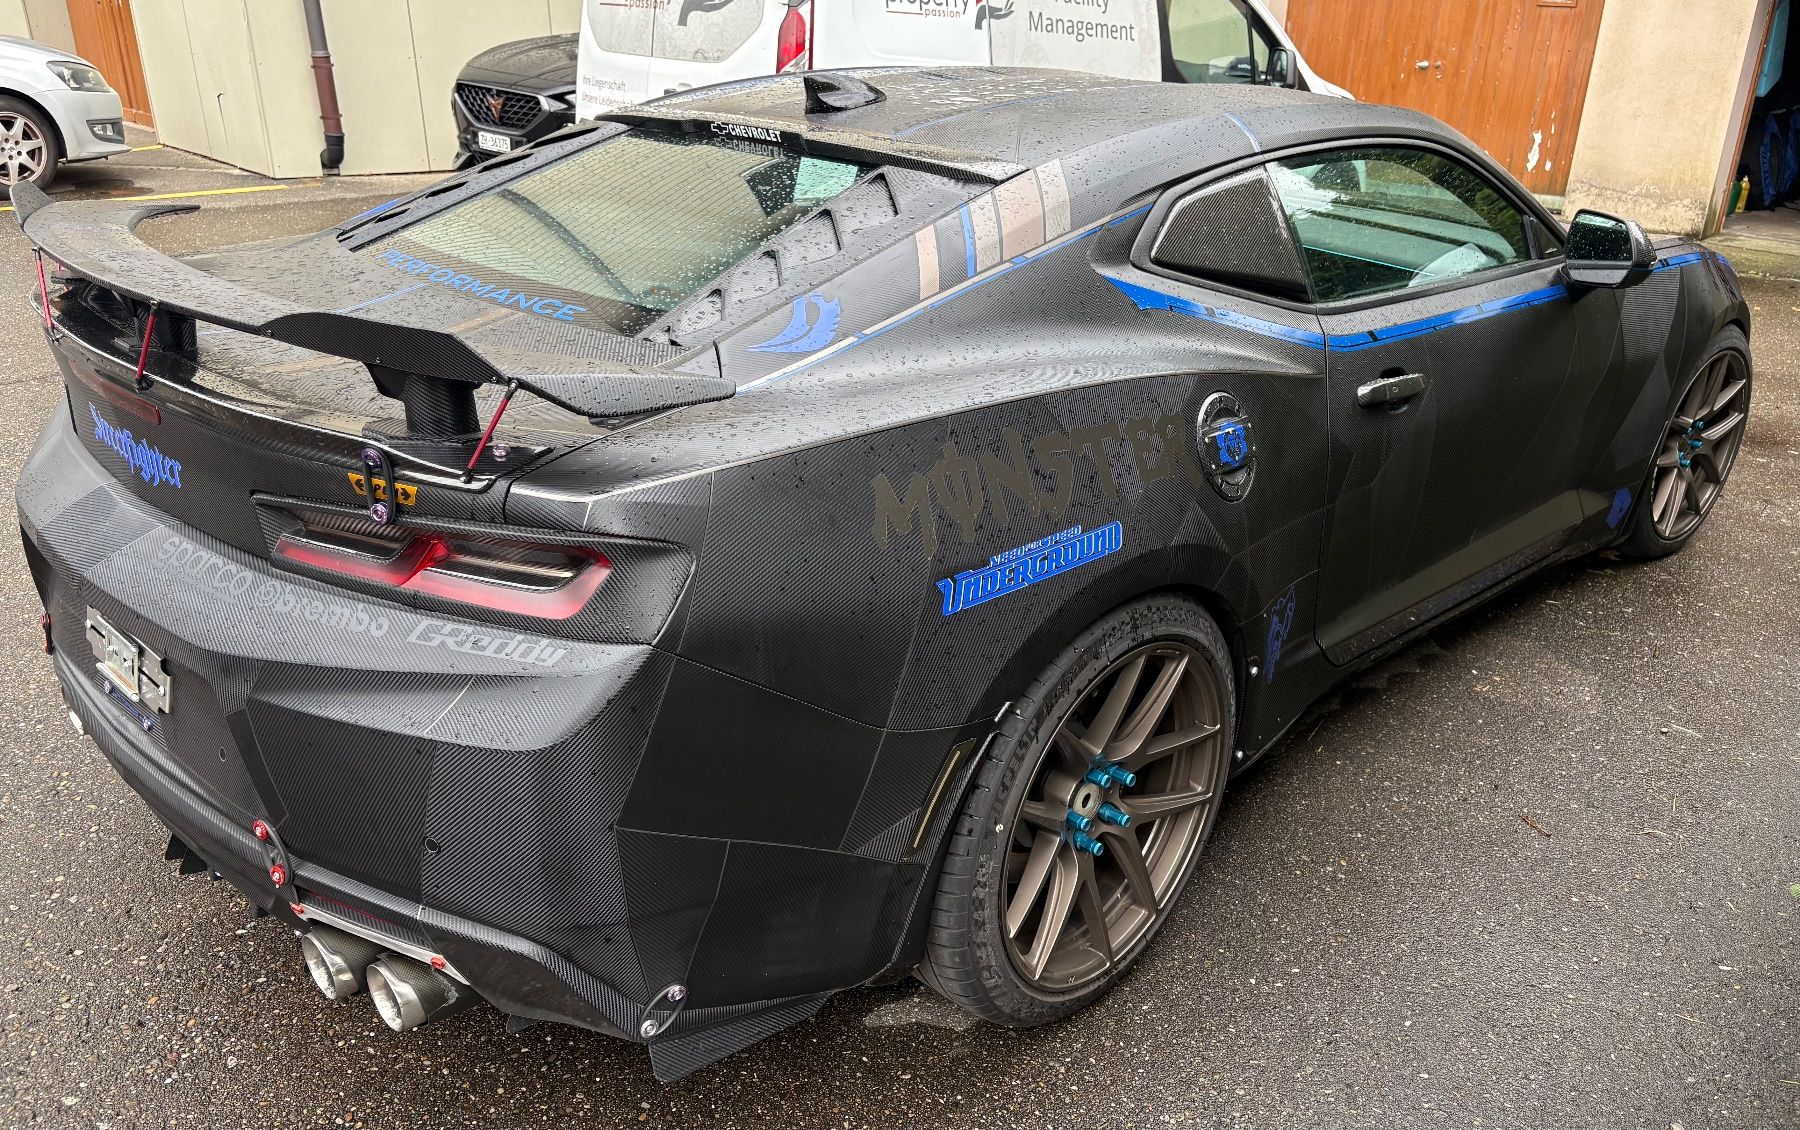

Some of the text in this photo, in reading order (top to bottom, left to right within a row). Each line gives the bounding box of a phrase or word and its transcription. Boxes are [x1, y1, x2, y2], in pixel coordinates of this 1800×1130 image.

[629, 0, 665, 10] passion
[886, 0, 969, 15] pperty
[924, 8, 961, 18] passion
[1028, 10, 1135, 42] Management
[728, 123, 782, 143] CHEVROLET
[375, 248, 588, 322] PERFORMANCE
[871, 413, 1202, 561] MONSTER
[989, 545, 1025, 568] NEED
[1042, 524, 1082, 549] SPEED
[935, 520, 1123, 617] UNDERGROUND
[274, 583, 390, 638] brembo
